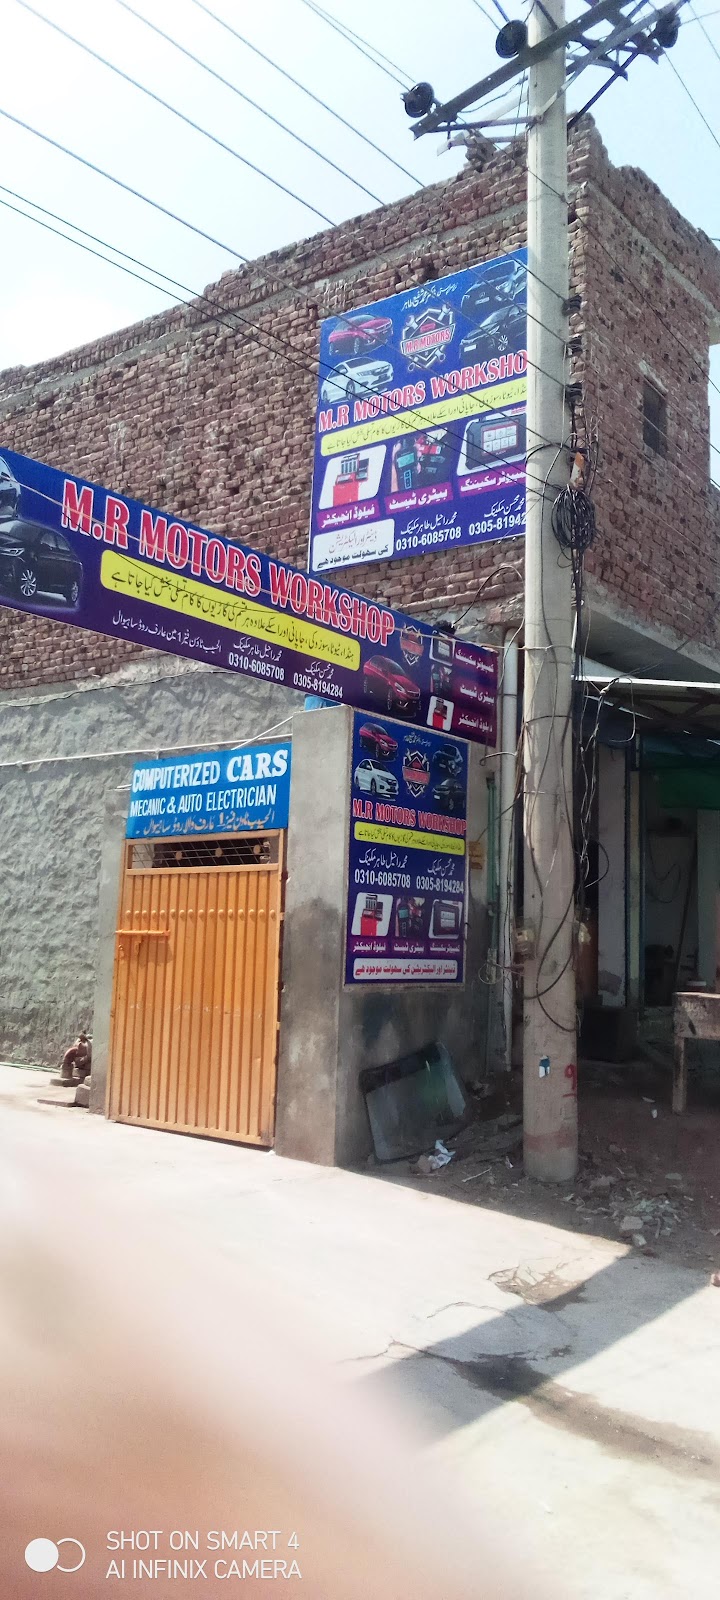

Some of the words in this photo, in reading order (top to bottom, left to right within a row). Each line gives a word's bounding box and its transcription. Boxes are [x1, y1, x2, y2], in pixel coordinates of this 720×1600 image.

[419, 327, 451, 348] MOTORS
[318, 404, 350, 433] M.R
[353, 380, 426, 423] MOTORS
[430, 349, 528, 399] WORKSHO
[417, 487, 448, 506] بیٹری
[468, 511, 527, 536] 0305-81942
[395, 525, 462, 552] 0310-6085708
[330, 553, 352, 566] موجود
[351, 548, 377, 560] سہولت
[377, 544, 389, 556] کی
[61, 478, 130, 550] M.R
[138, 509, 262, 598] MOTORS
[268, 561, 395, 647] WORKSHOP
[316, 557, 329, 569] ہے
[111, 571, 127, 589] ہے
[128, 570, 144, 594] جاتا
[112, 610, 138, 630] ساہیوال
[148, 623, 167, 638] عارف
[288, 621, 305, 650] جاپانی
[228, 651, 285, 681] 0310-6085708
[293, 672, 343, 699] 0305-8194284
[132, 760, 221, 793] COMPUTERIZED
[226, 749, 289, 783] CARS
[130, 796, 167, 817] MECANIC
[166, 795, 177, 815] &
[177, 793, 203, 814] AUTO
[206, 784, 277, 812] ELECTRICIAN
[352, 798, 373, 820] M.R
[375, 802, 416, 828] MOTORS
[418, 810, 467, 837] WORKSHOP
[354, 868, 411, 889] 0310-6085708
[415, 875, 465, 895] 0305-8194284
